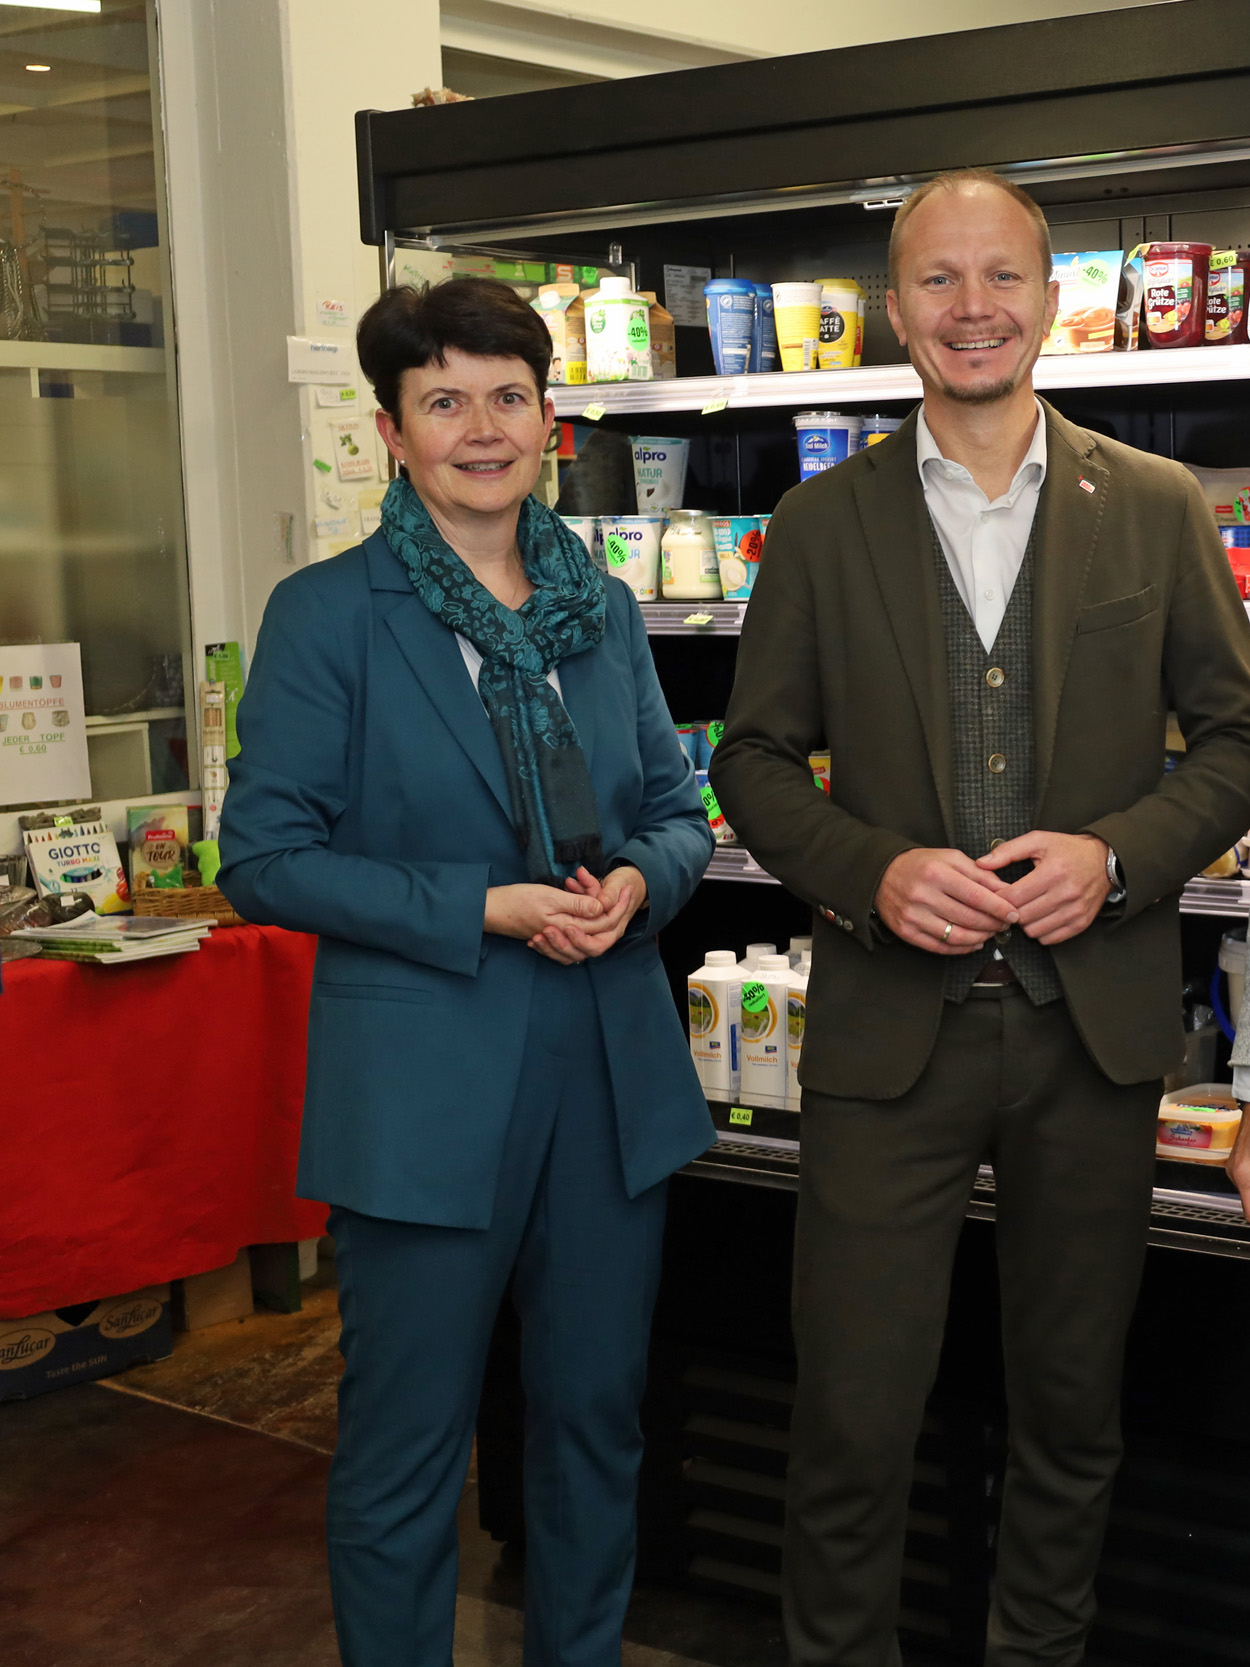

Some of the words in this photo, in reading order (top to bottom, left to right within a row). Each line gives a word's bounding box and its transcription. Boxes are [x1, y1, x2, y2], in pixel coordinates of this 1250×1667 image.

[1216, 256, 1234, 265] 0,60
[1082, 266, 1108, 284] -40%
[1151, 288, 1169, 298] Rote
[1148, 297, 1175, 309] Grütze
[820, 315, 840, 325] AFFÈ
[627, 327, 648, 338] -40%
[820, 325, 840, 333] ATTE
[635, 447, 667, 464] alpro
[638, 467, 663, 479] NATUR
[608, 538, 626, 564] -40%
[747, 531, 761, 561] -20%
[3, 735, 30, 745] JEDER
[40, 732, 65, 742] TOPF
[29, 744, 47, 753] 0,60
[48, 842, 100, 860] GIOTTO
[146, 850, 176, 862] TOUR
[56, 858, 81, 867] TURBO
[82, 855, 100, 865] MAXI
[694, 1049, 722, 1059] Vollmilch
[747, 1054, 778, 1063] Vollmilch
[105, 1302, 158, 1333] SanLucar
[46, 1365, 70, 1379] Taste
[71, 1361, 87, 1373] the
